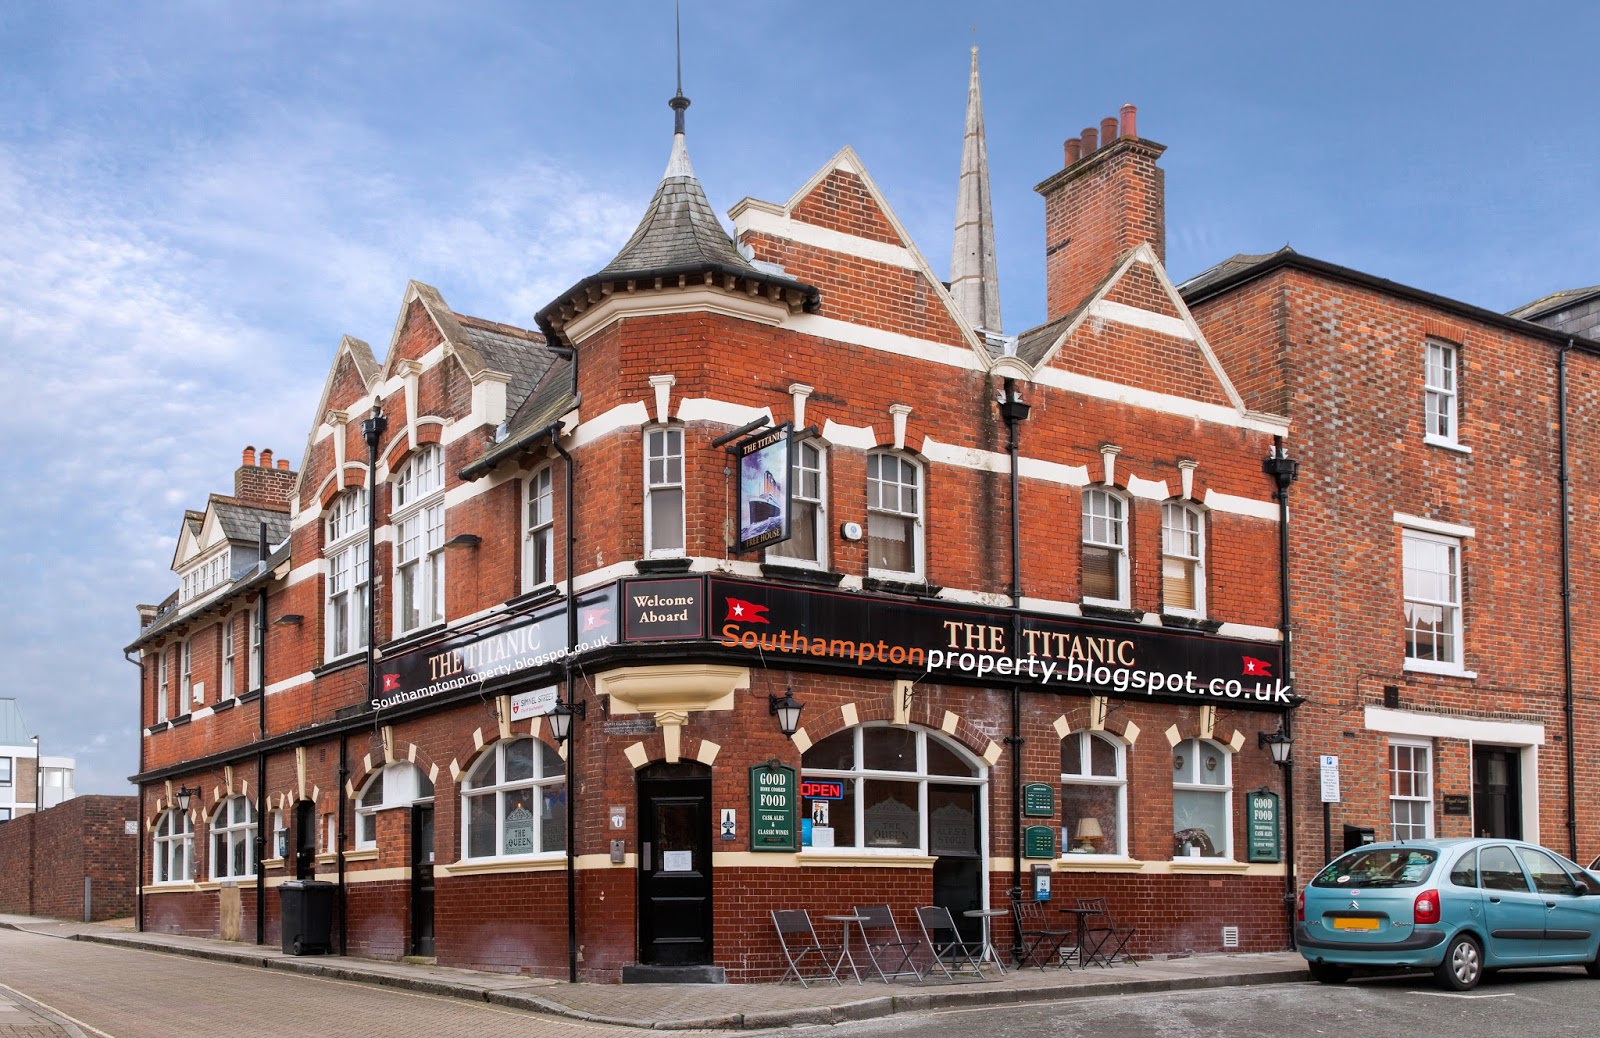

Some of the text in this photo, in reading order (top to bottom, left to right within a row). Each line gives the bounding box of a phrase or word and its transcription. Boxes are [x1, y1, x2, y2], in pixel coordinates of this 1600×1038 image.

[743, 430, 785, 455] THE TITANIC
[760, 528, 781, 542] HOUSE
[633, 594, 694, 608] Welcome
[639, 610, 689, 623] Aboard
[943, 620, 1136, 667] THE TITANIC
[428, 623, 541, 681] THE TITANIC
[760, 773, 786, 786] GOOD
[801, 783, 840, 797] OPEN
[760, 794, 786, 806] FOOD
[1254, 798, 1273, 808] GOOD
[1254, 810, 1273, 820] FOOD
[882, 822, 901, 830] THE
[514, 829, 526, 837] THE
[873, 829, 909, 840] QUEEN
[508, 838, 531, 847] QUEEN
